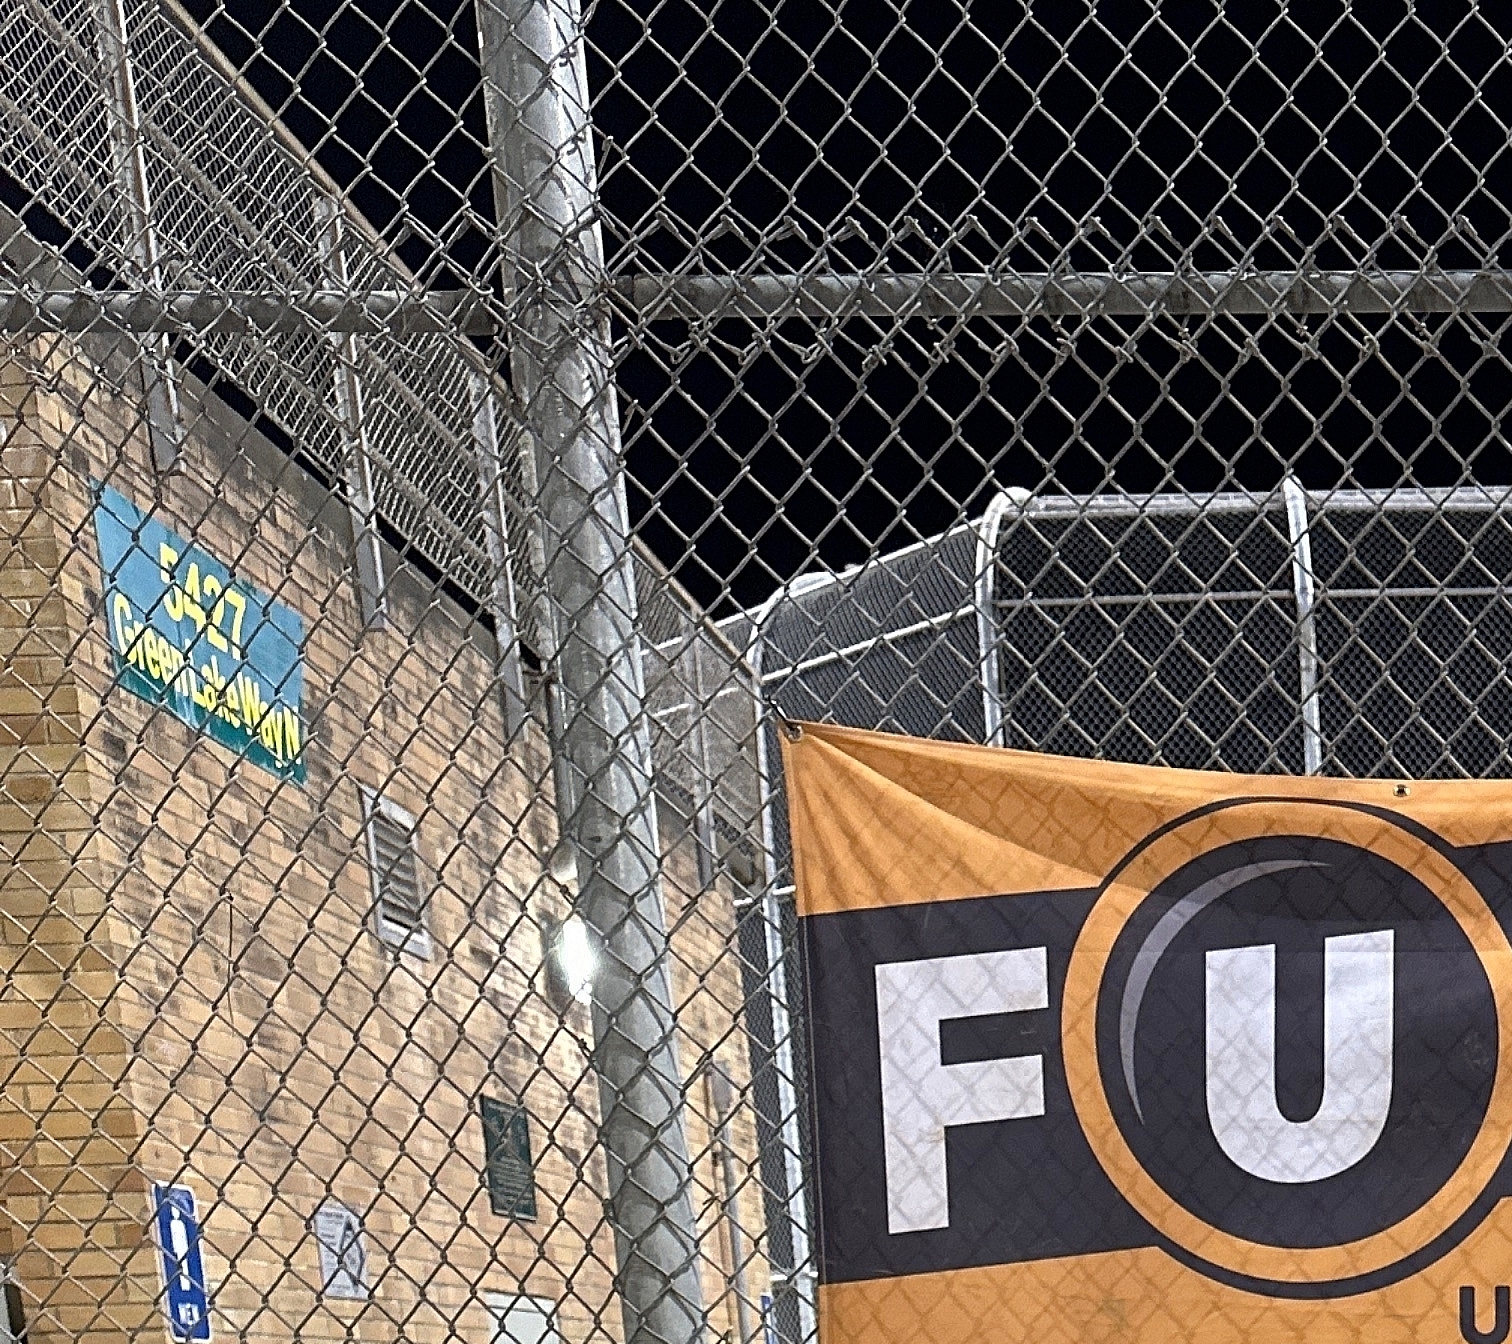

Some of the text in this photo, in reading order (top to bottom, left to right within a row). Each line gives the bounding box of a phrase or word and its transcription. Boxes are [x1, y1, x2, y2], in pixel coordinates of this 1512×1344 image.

[160, 542, 246, 661] 5427
[113, 592, 190, 697] Green
[185, 638, 241, 729] Lake
[239, 671, 283, 769] Way
